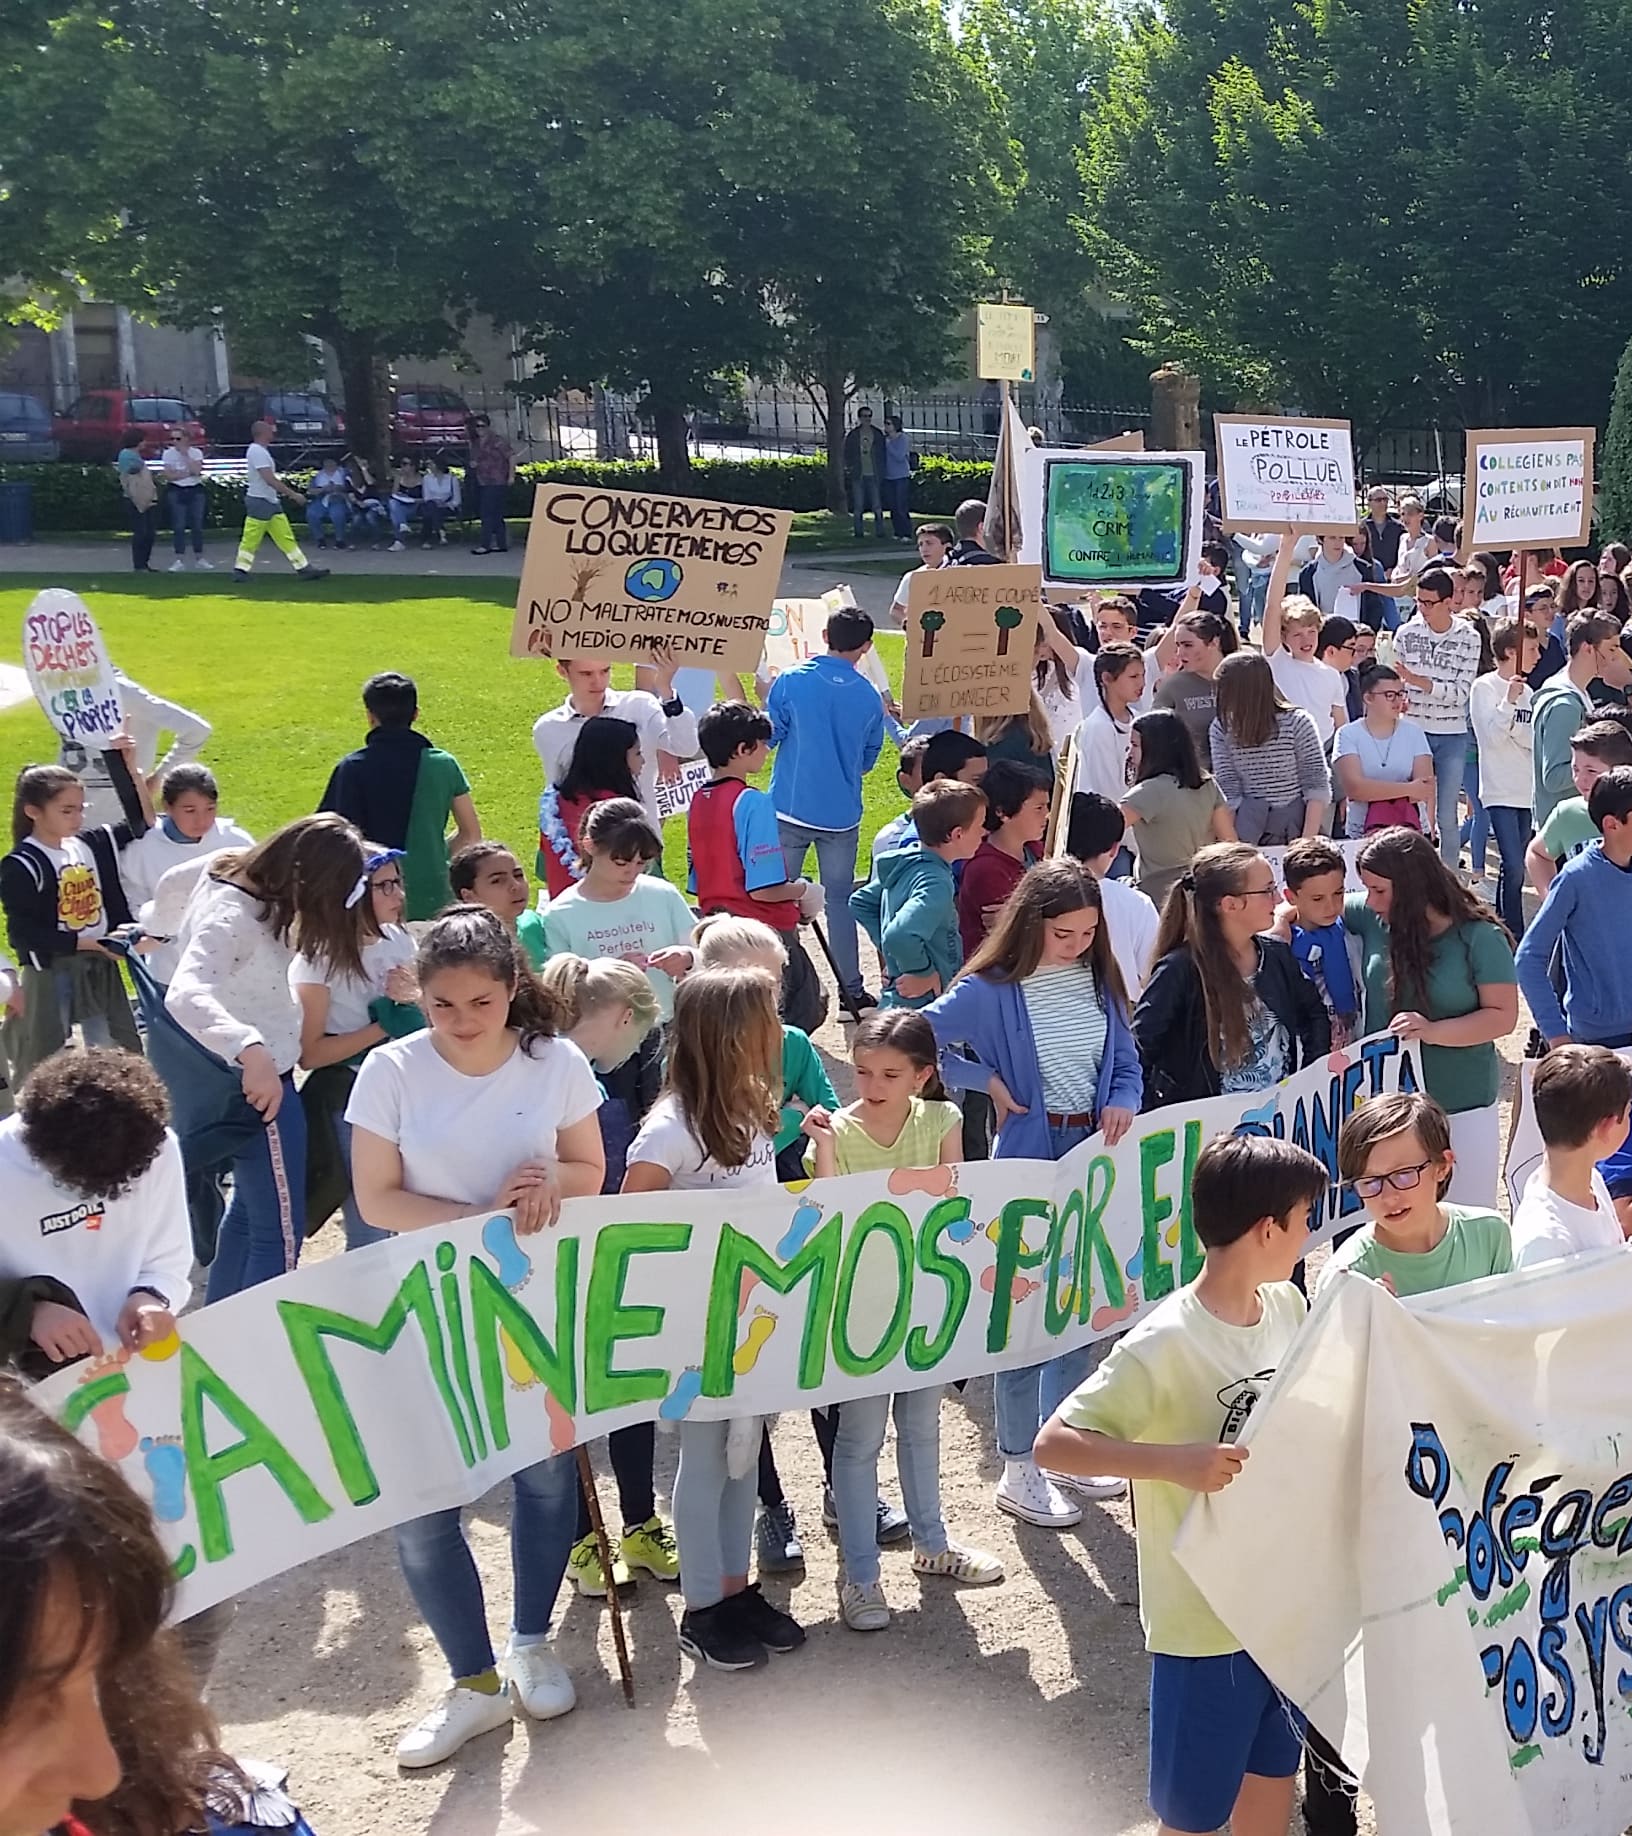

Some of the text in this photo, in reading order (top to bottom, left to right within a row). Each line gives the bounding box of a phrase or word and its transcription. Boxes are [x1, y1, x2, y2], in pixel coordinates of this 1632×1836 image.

[1235, 426, 1330, 450] LE PÉTROLE
[1479, 478, 1538, 498] CONTENTS
[546, 493, 776, 536] CONSERVEMOS
[945, 586, 989, 604] ARBRE
[528, 599, 571, 625] NO
[28, 611, 72, 644] STOP
[951, 686, 1011, 709] DANGER
[587, 920, 655, 941] Absolutely
[599, 938, 644, 955] Perfect
[43, 1213, 71, 1233] JUST
[71, 1206, 87, 1223] DO
[987, 1155, 1126, 1354] POR
